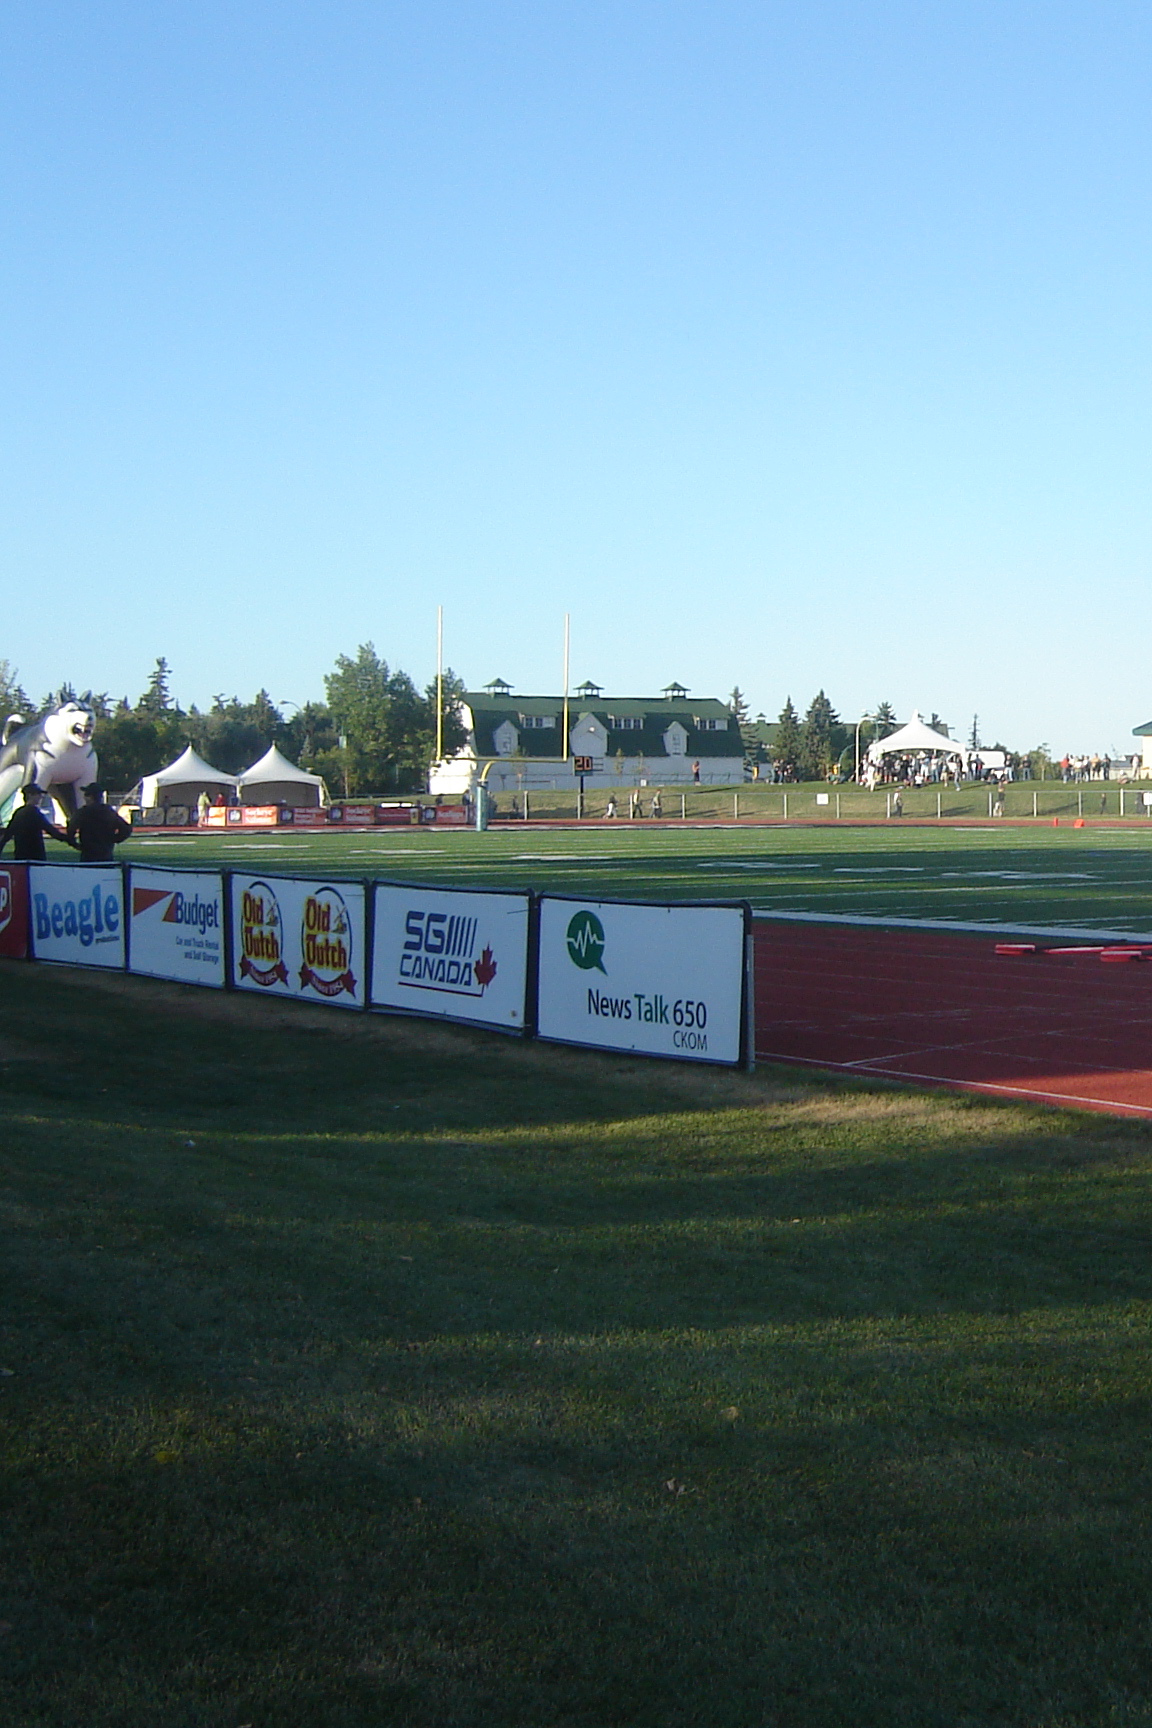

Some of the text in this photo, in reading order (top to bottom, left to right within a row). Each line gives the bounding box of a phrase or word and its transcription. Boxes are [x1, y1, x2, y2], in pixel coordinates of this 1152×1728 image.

[574, 756, 592, 771] 20
[34, 884, 119, 946] Beagle
[175, 892, 219, 935] Budget
[243, 890, 264, 926] Old
[305, 897, 331, 933] Old
[244, 926, 279, 961] Dutch
[305, 933, 347, 970] Dutch
[400, 954, 472, 986] CANADA
[587, 988, 707, 1029] News Talk 650
[673, 1030, 707, 1051] CKOM
